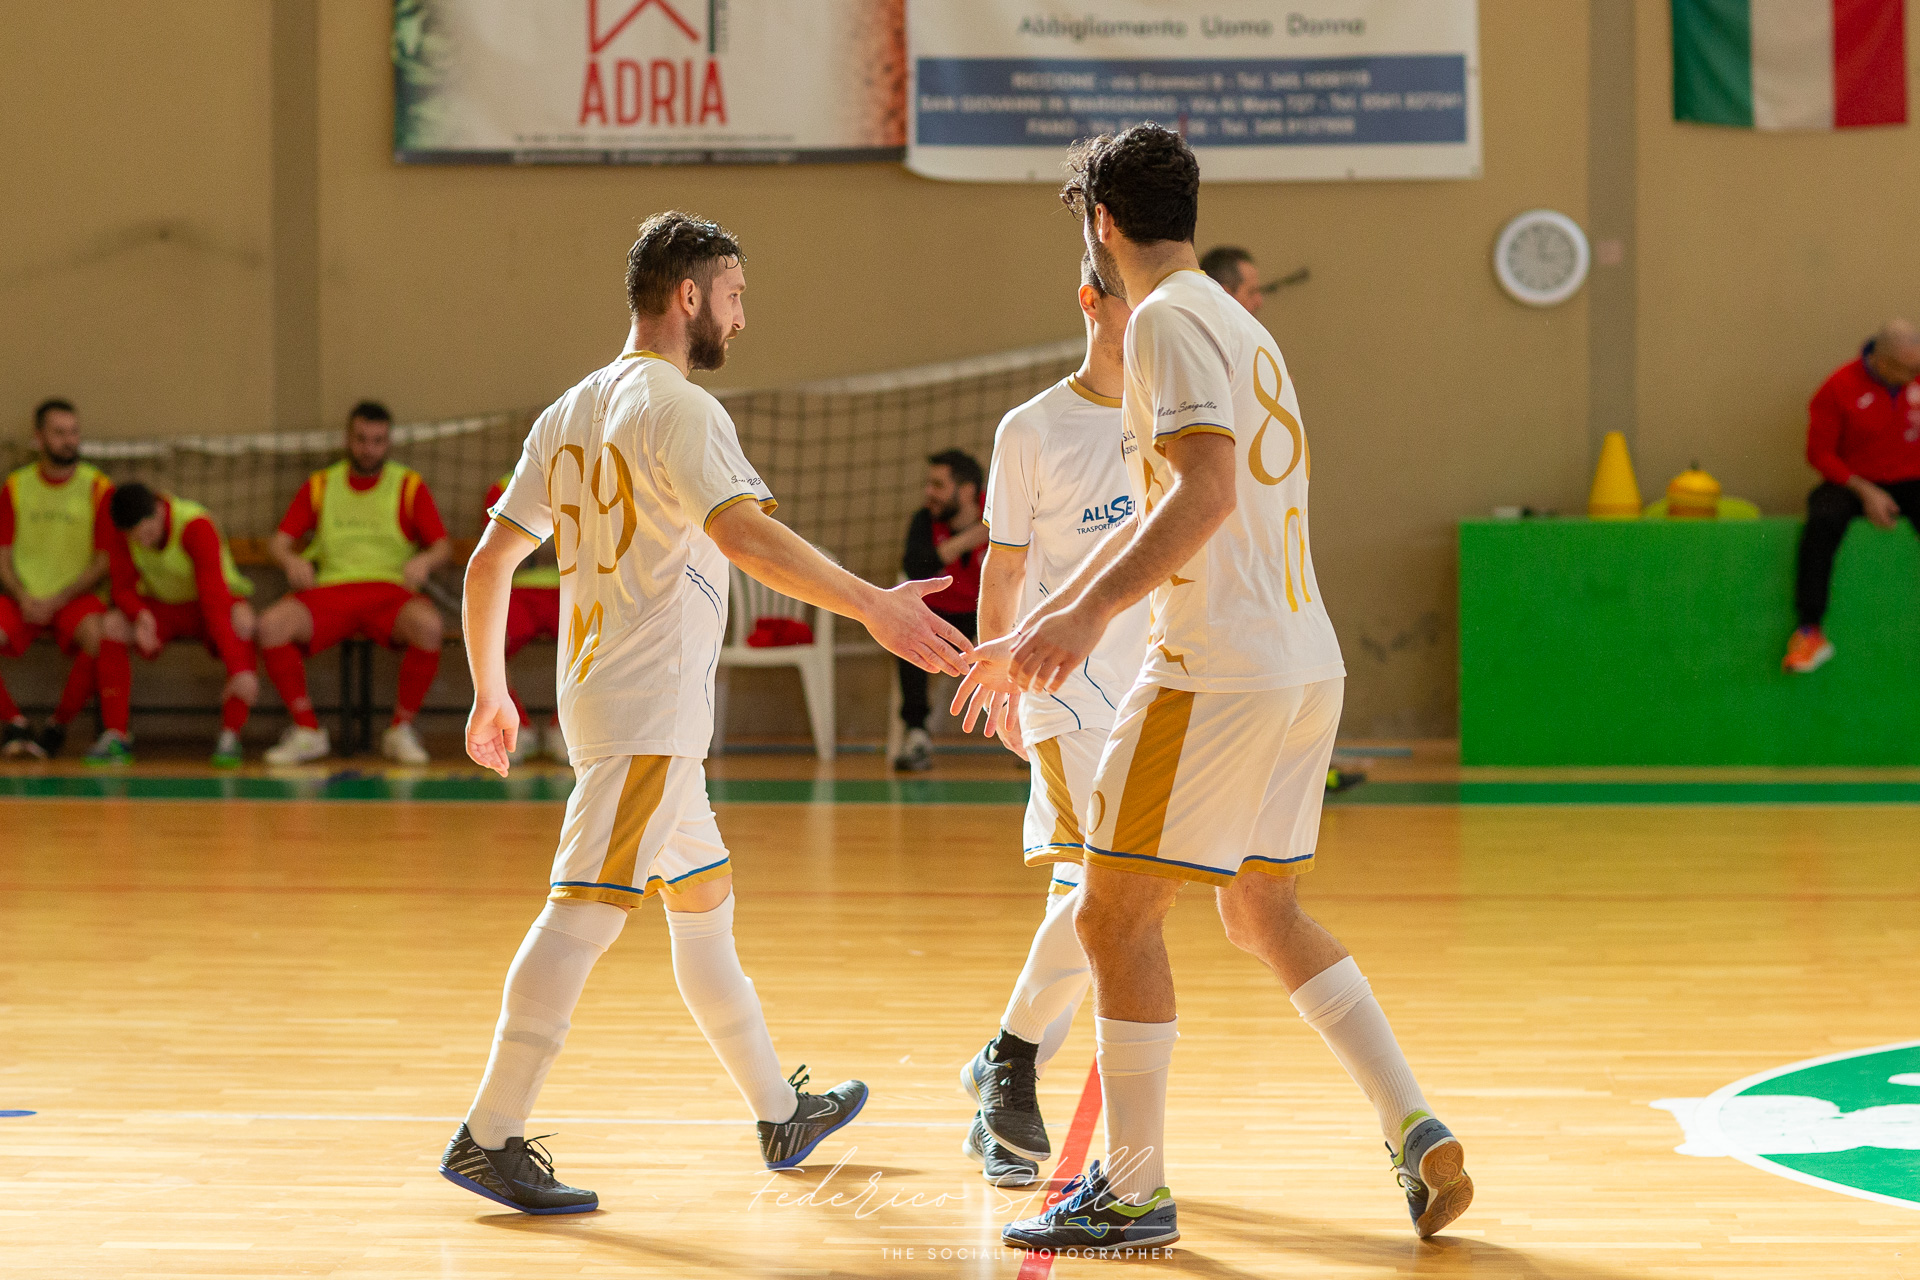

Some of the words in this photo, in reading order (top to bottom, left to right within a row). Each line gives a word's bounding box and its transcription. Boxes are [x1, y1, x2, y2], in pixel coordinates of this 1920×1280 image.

[1018, 15, 1186, 41] Abbigliamento
[1202, 16, 1272, 37] Uomo
[1288, 14, 1365, 36] Donna
[579, 58, 727, 126] ADRIA
[1248, 345, 1311, 486] 8
[548, 441, 637, 577] 69
[1082, 495, 1136, 523] ALLSE
